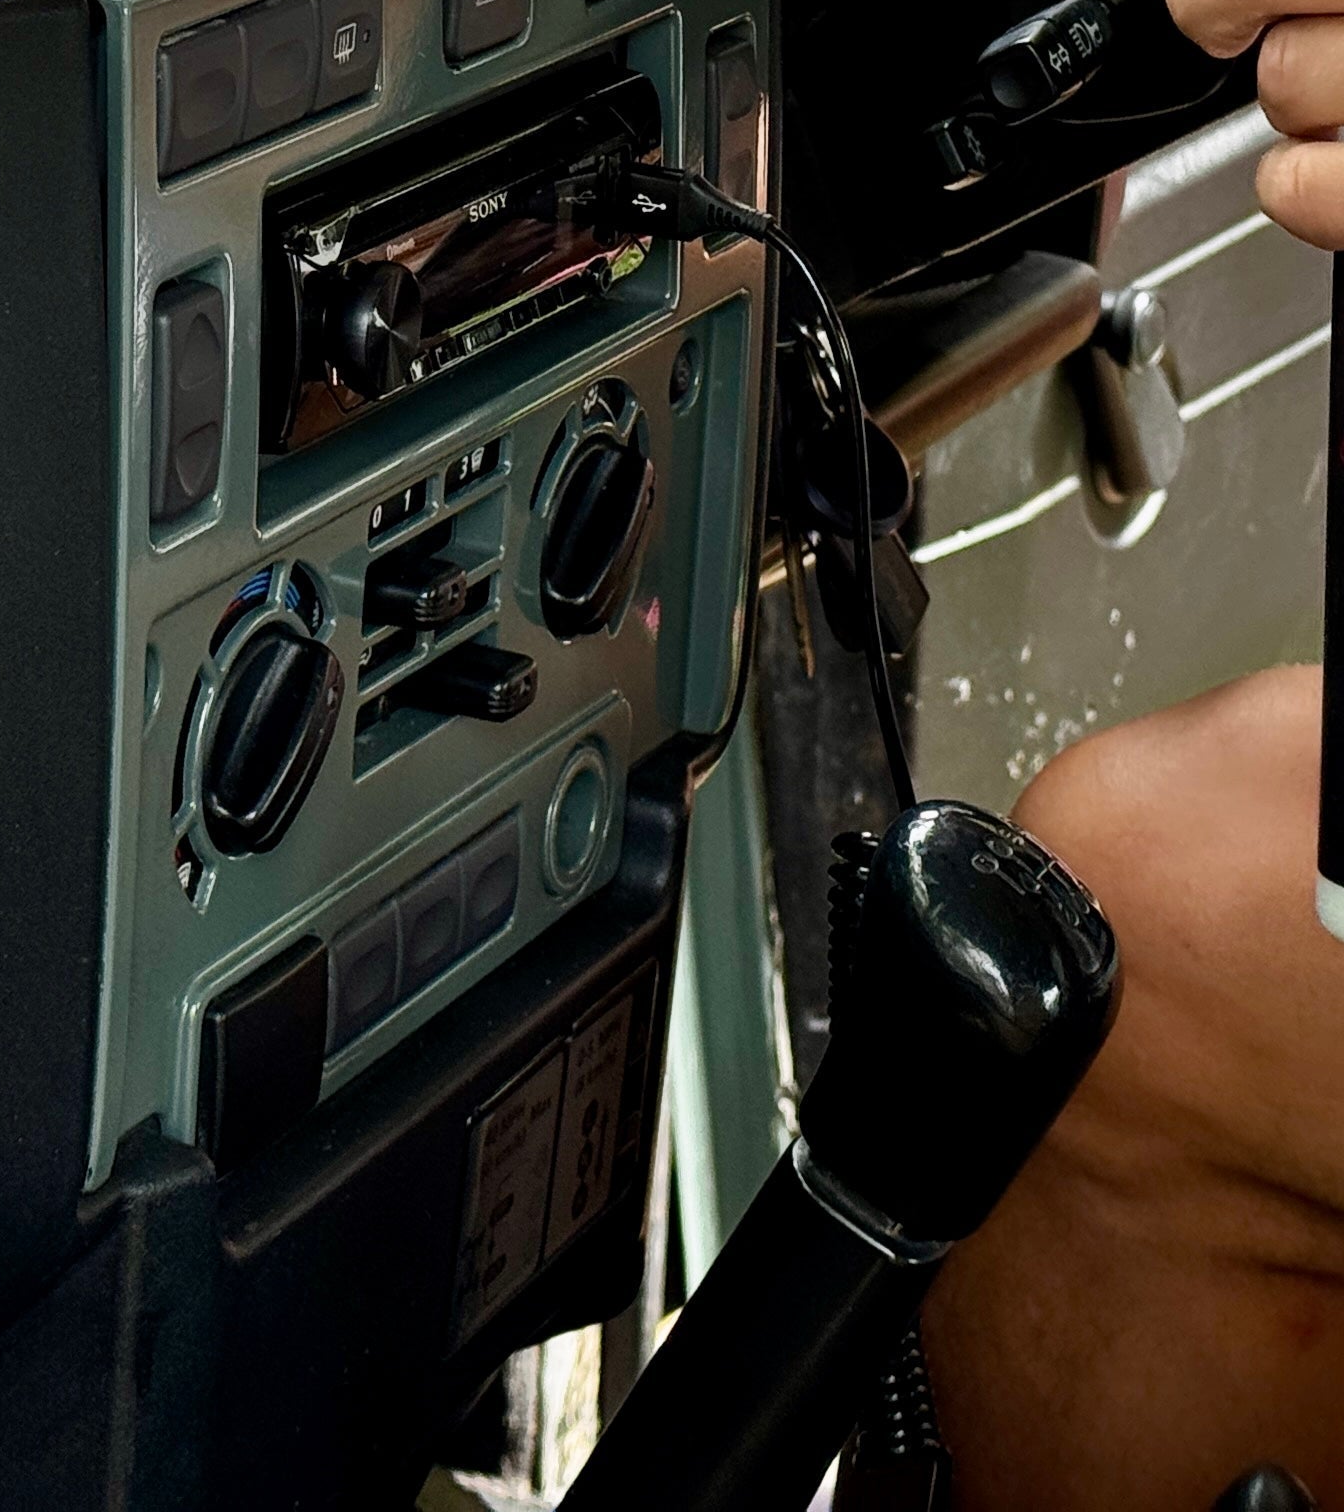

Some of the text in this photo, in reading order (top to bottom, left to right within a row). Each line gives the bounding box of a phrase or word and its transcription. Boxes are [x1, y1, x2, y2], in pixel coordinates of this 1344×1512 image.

[469, 191, 508, 223] SONY
[404, 488, 412, 513] 1
[459, 455, 469, 481] 3
